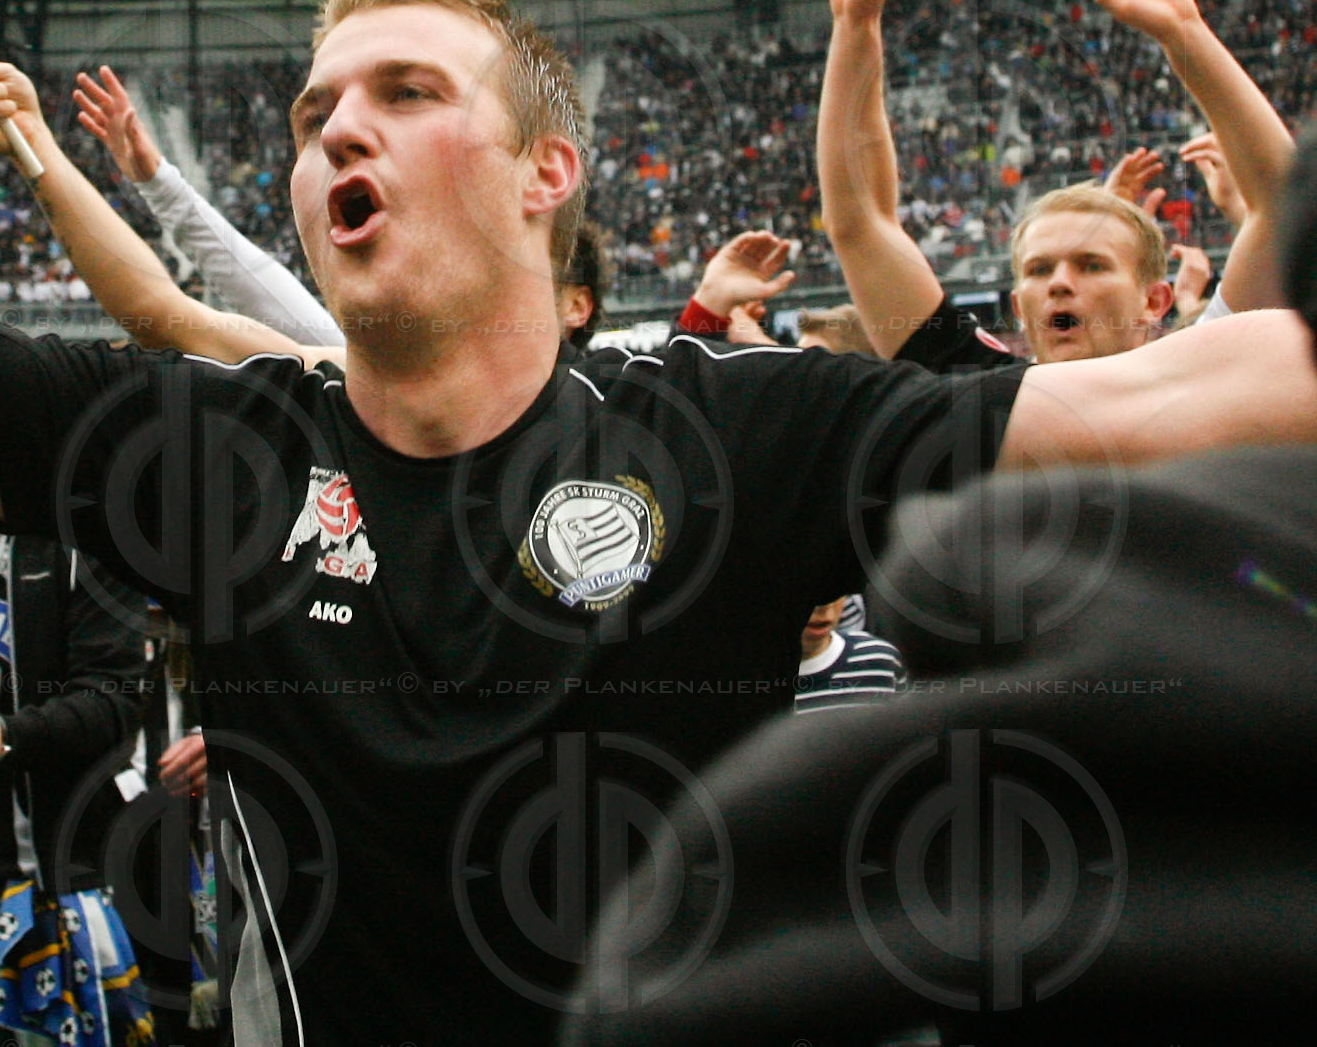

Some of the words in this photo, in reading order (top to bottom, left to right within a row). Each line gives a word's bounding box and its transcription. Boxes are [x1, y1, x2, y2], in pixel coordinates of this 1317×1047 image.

[540, 489, 567, 519] JAHRE
[568, 487, 581, 497] SK
[582, 487, 619, 500] STURM
[622, 495, 644, 520] GRAZ
[565, 565, 645, 602] PUNTIGAMER
[309, 601, 353, 624] AKO
